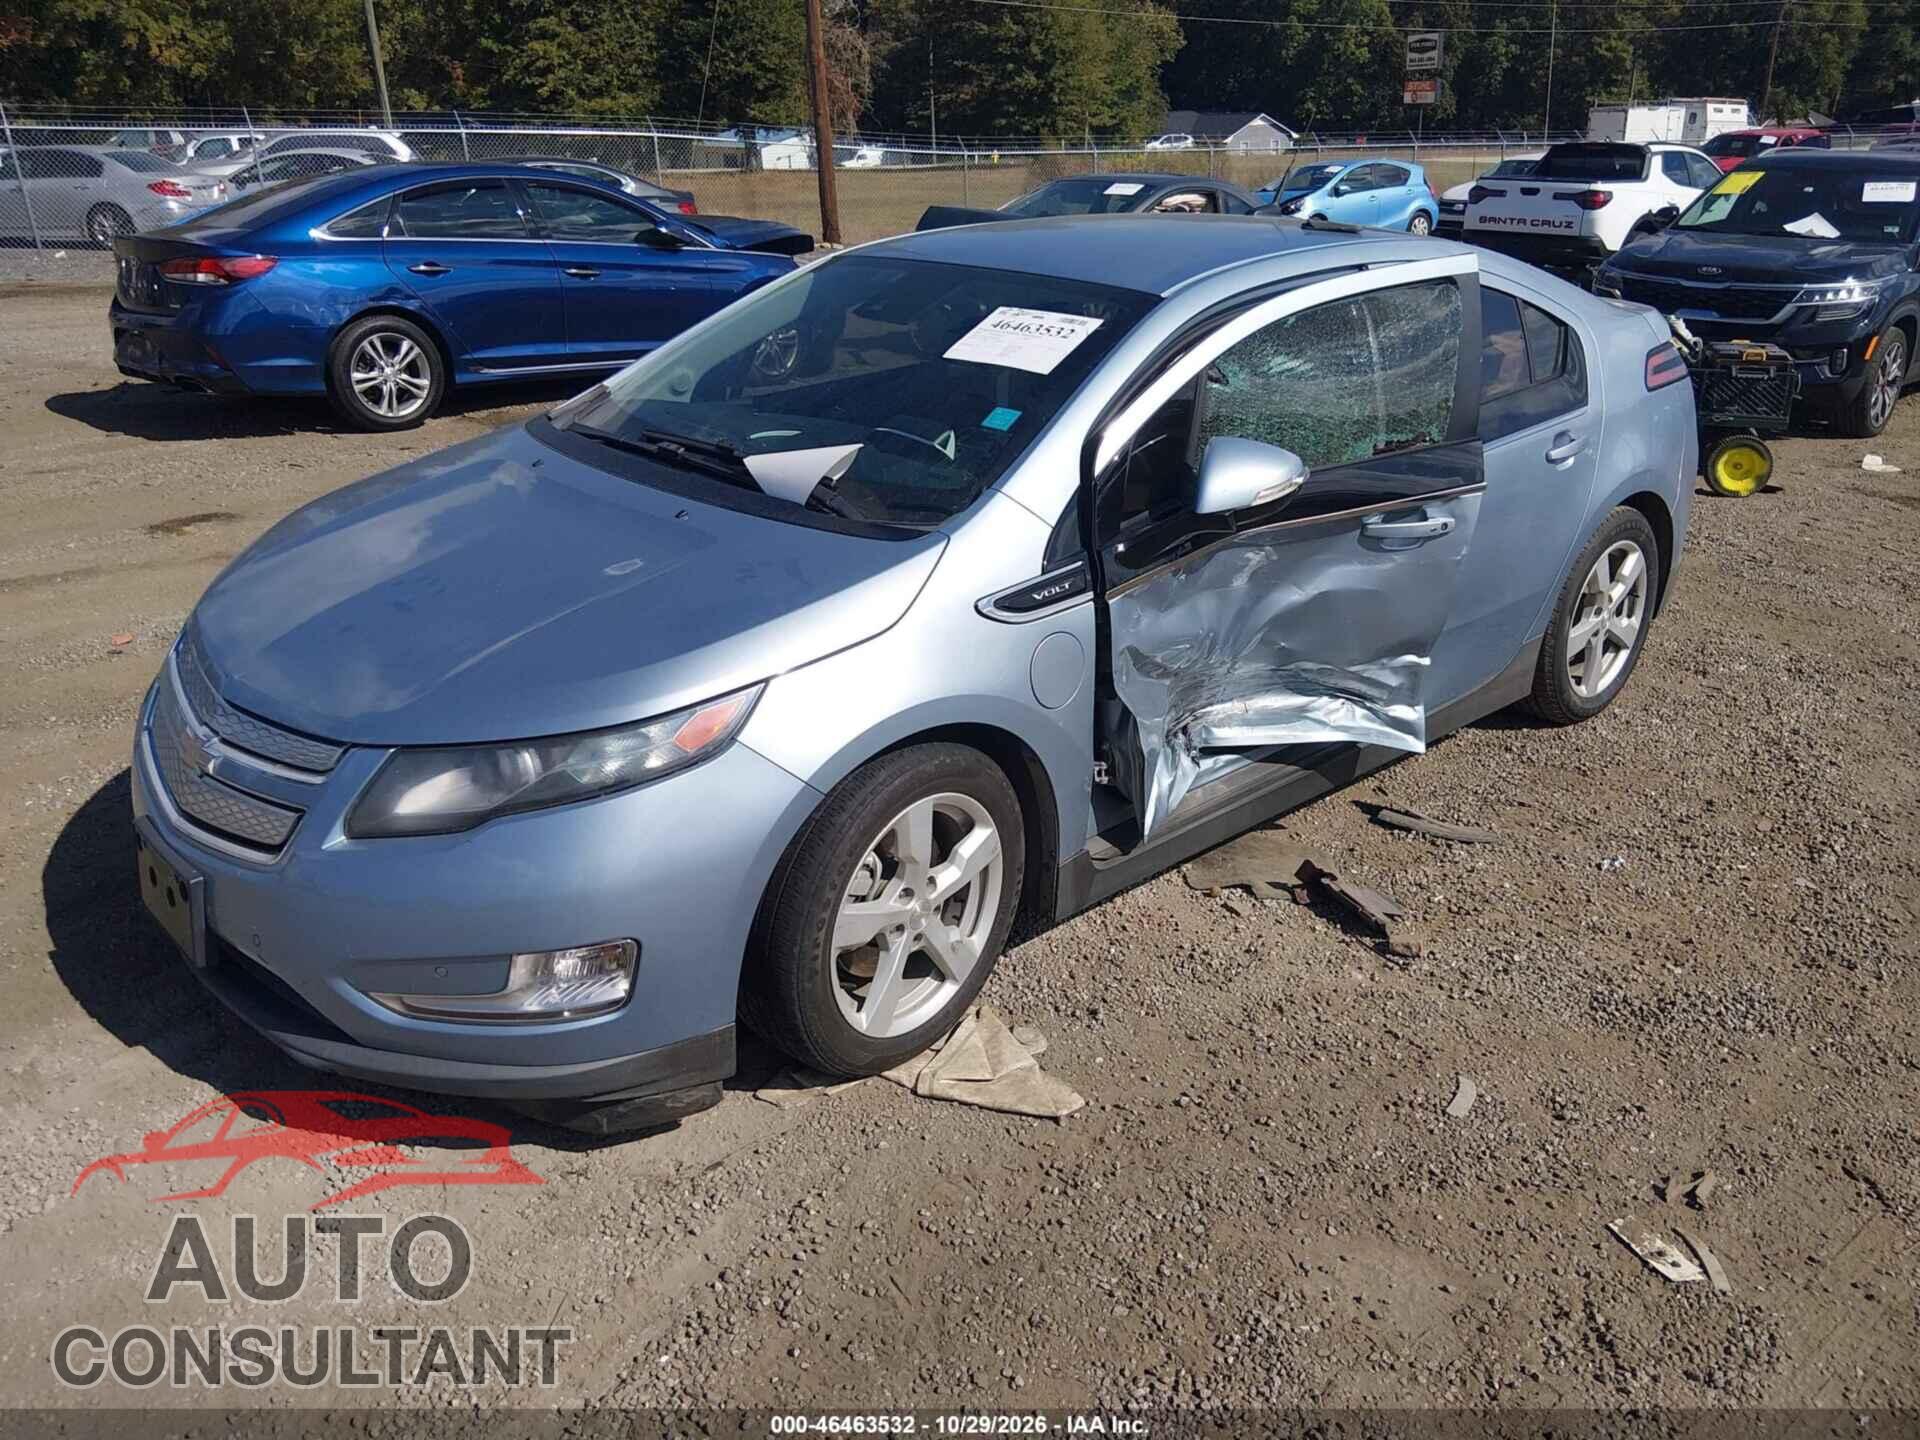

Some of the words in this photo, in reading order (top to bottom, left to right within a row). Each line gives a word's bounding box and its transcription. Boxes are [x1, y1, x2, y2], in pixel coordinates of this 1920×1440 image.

[1479, 216, 1527, 227] SANTA
[1530, 218, 1574, 229] CRUZ
[991, 319, 1075, 339] 46463532
[1031, 582, 1073, 600] VOLT
